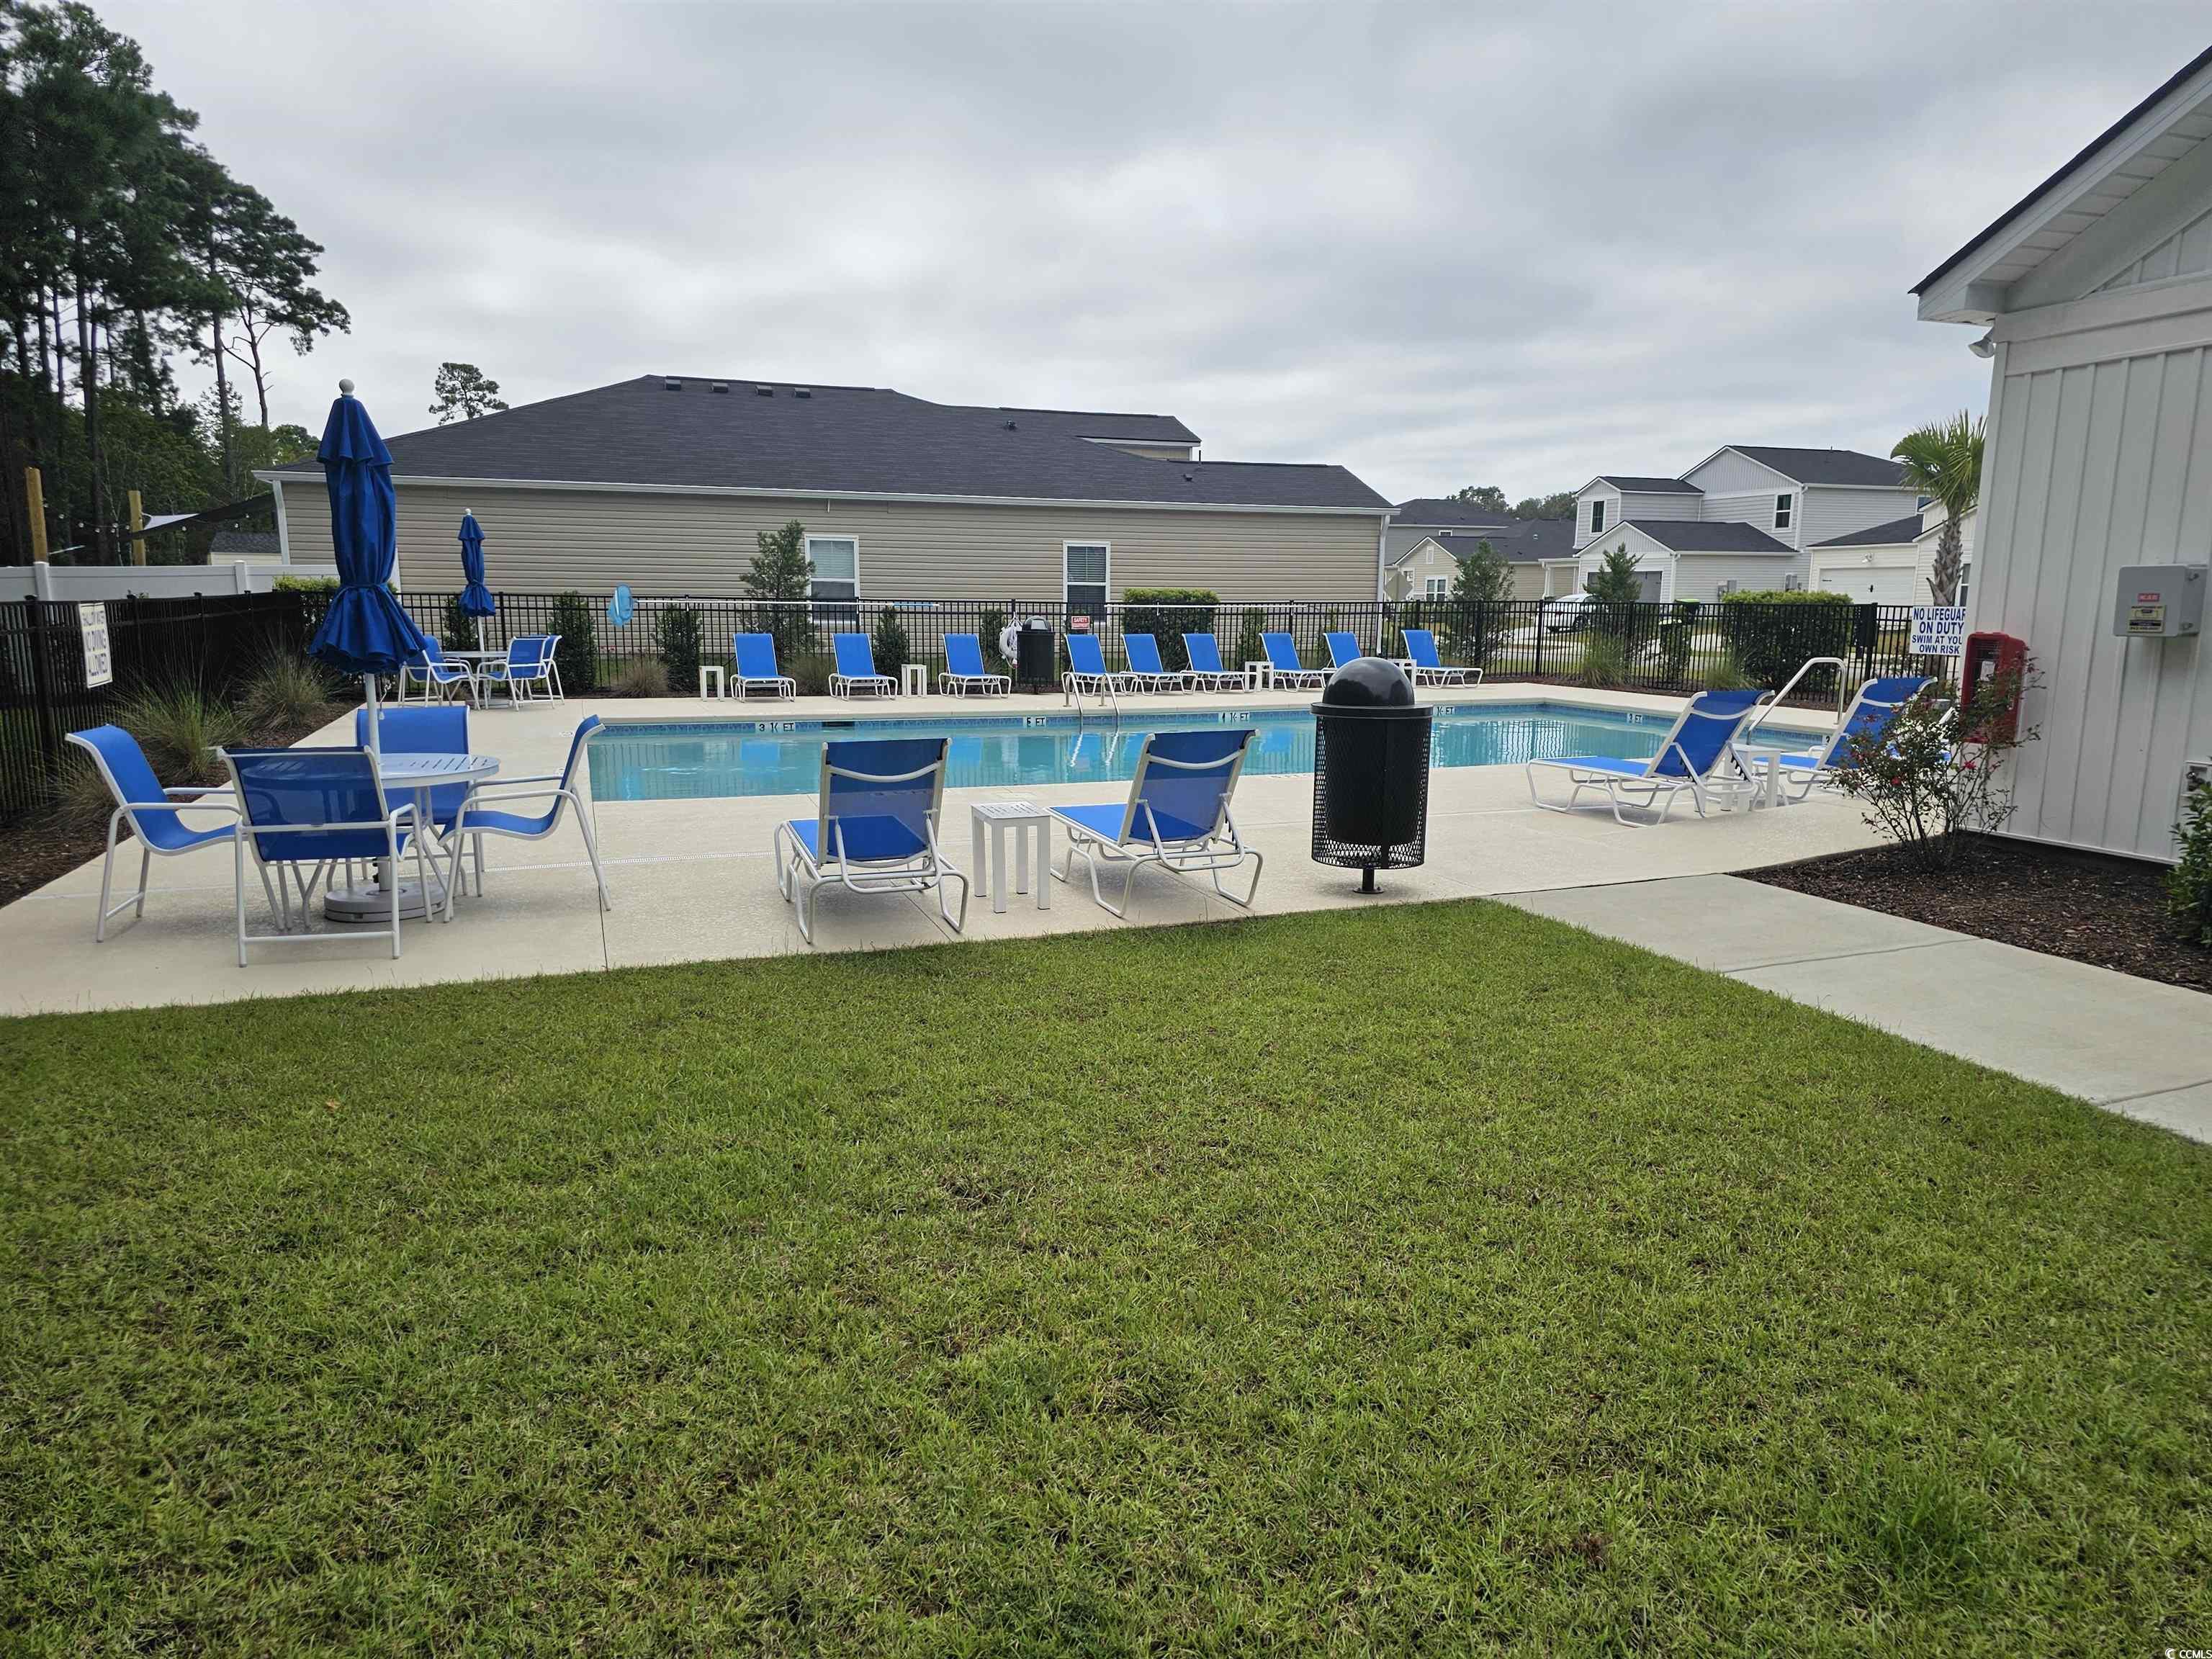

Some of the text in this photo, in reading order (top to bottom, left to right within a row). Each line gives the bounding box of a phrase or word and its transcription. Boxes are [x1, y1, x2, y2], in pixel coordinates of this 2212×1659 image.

[1913, 608, 1925, 620] NO
[1919, 621, 1964, 634] ON DUTY
[1935, 636, 1945, 644] AT
[1940, 645, 1960, 655] RISK
[1446, 706, 1454, 715] FT
[1035, 717, 1046, 727] FT
[1240, 713, 1249, 721] FT
[759, 723, 765, 732] 3
[783, 722, 794, 732] FT
